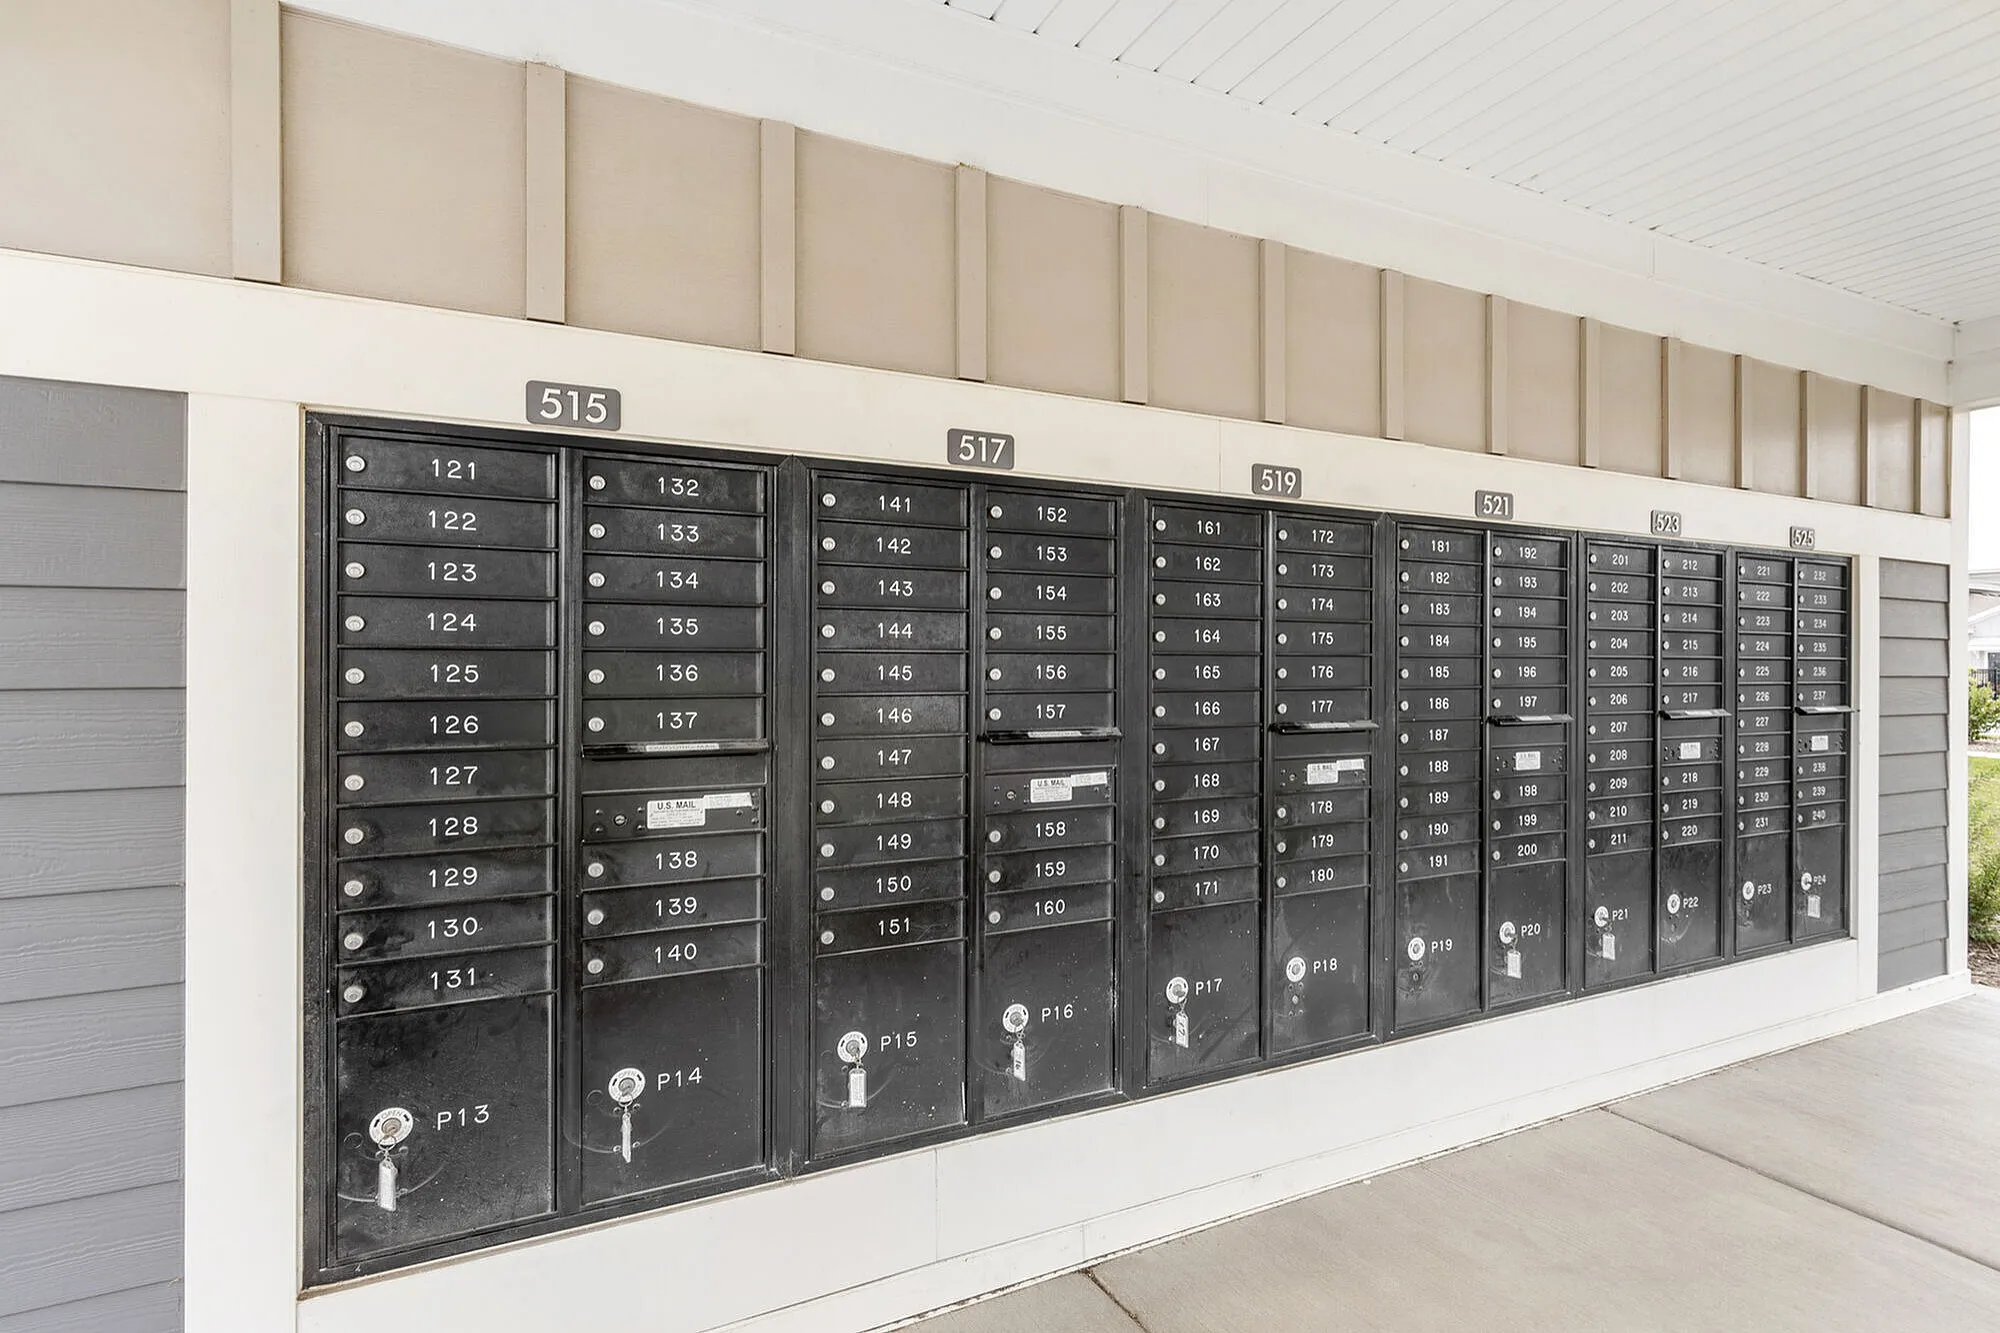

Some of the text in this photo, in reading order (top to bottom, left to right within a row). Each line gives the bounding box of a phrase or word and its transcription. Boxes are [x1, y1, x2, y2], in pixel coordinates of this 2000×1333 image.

[540, 388, 606, 423] 515
[960, 435, 1006, 463] 517
[432, 459, 474, 479] 121
[659, 477, 698, 496] 132
[1262, 469, 1296, 494] 519
[880, 496, 910, 512] 141
[1484, 495, 1508, 515] 521
[429, 510, 476, 530] 122
[1038, 506, 1066, 522] 152
[1198, 521, 1220, 535] 161
[1656, 515, 1679, 533] 523
[658, 524, 699, 542] 133
[1313, 530, 1333, 543] 172
[1794, 530, 1814, 547] 525
[877, 537, 911, 554] 142
[1432, 540, 1449, 552] 181
[1038, 546, 1066, 561] 153
[1520, 547, 1536, 559] 192
[1196, 557, 1220, 571] 162
[1613, 554, 1628, 565] 201
[1683, 560, 1697, 570] 212
[428, 562, 476, 581] 123
[1313, 564, 1334, 577] 173
[1757, 566, 1769, 575] 221
[1814, 571, 1826, 580] 232
[657, 571, 698, 588] 134
[1431, 572, 1449, 584] 182
[1520, 577, 1537, 588] 193
[879, 580, 913, 596] 143
[1037, 586, 1066, 600] 154
[1612, 582, 1628, 593] 202
[1683, 587, 1697, 597] 213
[1196, 593, 1220, 606] 163
[1756, 591, 1769, 601] 222
[1815, 595, 1826, 604] 233
[1312, 598, 1333, 610] 174
[1431, 603, 1449, 615] 183
[1519, 607, 1536, 618] 194
[1611, 610, 1628, 621] 203
[1682, 613, 1697, 623] 214
[428, 613, 476, 631] 124
[657, 618, 698, 635] 135
[1756, 616, 1770, 626] 223
[1814, 619, 1826, 628] 234
[879, 623, 912, 638] 144
[1037, 626, 1066, 640] 155
[1195, 630, 1220, 642] 164
[1312, 632, 1333, 644] 175
[1431, 635, 1449, 646] 184
[1519, 637, 1536, 648] 195
[1611, 638, 1627, 648] 204
[1683, 640, 1698, 650] 215
[1756, 641, 1769, 651] 224
[1814, 643, 1826, 652] 235
[431, 665, 478, 682] 125
[657, 665, 697, 681] 136
[879, 665, 912, 680] 145
[1037, 665, 1066, 679] 156
[1196, 666, 1220, 679] 165
[1312, 666, 1333, 678] 176
[1430, 666, 1449, 678] 185
[1519, 666, 1536, 677] 196
[1611, 666, 1628, 676] 205
[1683, 667, 1697, 676] 216
[1756, 666, 1769, 676] 225
[1814, 667, 1826, 676] 236
[1520, 696, 1537, 707] 197
[1611, 694, 1627, 704] 206
[1683, 693, 1697, 703] 217
[1756, 692, 1769, 701] 226
[1814, 691, 1825, 700] 237
[1195, 702, 1220, 715] 166
[1312, 701, 1332, 712] 177
[1430, 698, 1449, 709] 186
[878, 708, 911, 723] 146
[1037, 705, 1065, 718] 157
[431, 716, 478, 733] 126
[657, 712, 697, 728] 137
[1756, 717, 1769, 726] 227
[1611, 722, 1627, 732] 207
[1430, 729, 1448, 741] 187
[1195, 738, 1219, 751] 167
[1756, 742, 1769, 752] 228
[878, 750, 911, 765] 147
[1610, 750, 1627, 760] 208
[1429, 760, 1448, 772] 188
[1755, 767, 1768, 777] 229
[1813, 763, 1825, 772] 238
[431, 766, 477, 785] 127
[1195, 774, 1219, 787] 168
[1683, 772, 1697, 783] 218
[1610, 778, 1627, 789] 209
[1520, 785, 1537, 796] 198
[1813, 786, 1825, 796] 239
[878, 792, 911, 808] 148
[1430, 792, 1448, 803] 189
[1755, 792, 1769, 802] 230
[657, 800, 696, 810] U.S. MAIL
[1311, 801, 1332, 813] 178
[1683, 799, 1697, 809] 219
[1195, 809, 1219, 823] 169
[1610, 806, 1627, 817] 210
[1813, 810, 1825, 820] 240
[1519, 814, 1536, 826] 199
[1756, 818, 1768, 827] 231
[430, 817, 477, 836] 128
[1036, 822, 1065, 837] 158
[1429, 823, 1448, 835] 190
[1682, 825, 1697, 836] 220
[877, 834, 911, 850] 149
[1312, 835, 1333, 848] 179
[1611, 834, 1626, 845] 211
[1195, 845, 1219, 859] 170
[1518, 844, 1537, 856] 200
[656, 851, 697, 869] 138
[1430, 855, 1447, 867] 191
[1036, 862, 1065, 877] 159
[1312, 868, 1333, 882] 180
[429, 867, 477, 887] 129
[877, 876, 911, 893] 150
[1196, 881, 1217, 895] 171
[1758, 884, 1771, 894] P23
[656, 897, 697, 916] 139
[1036, 899, 1065, 915] 160
[1683, 897, 1698, 908] P22
[1613, 909, 1627, 921] P21
[428, 917, 477, 938] 130
[879, 918, 909, 935] 151
[1522, 923, 1540, 936] P20
[1432, 939, 1452, 953] P19
[655, 943, 696, 963] 140
[1314, 958, 1337, 973] P18
[431, 968, 474, 989] 131
[1196, 978, 1222, 995] P17
[1042, 1004, 1073, 1022] P16
[881, 1031, 917, 1051] P15
[658, 1067, 702, 1090] P14
[381, 1110, 403, 1119] OPEN
[438, 1105, 489, 1130] P13
